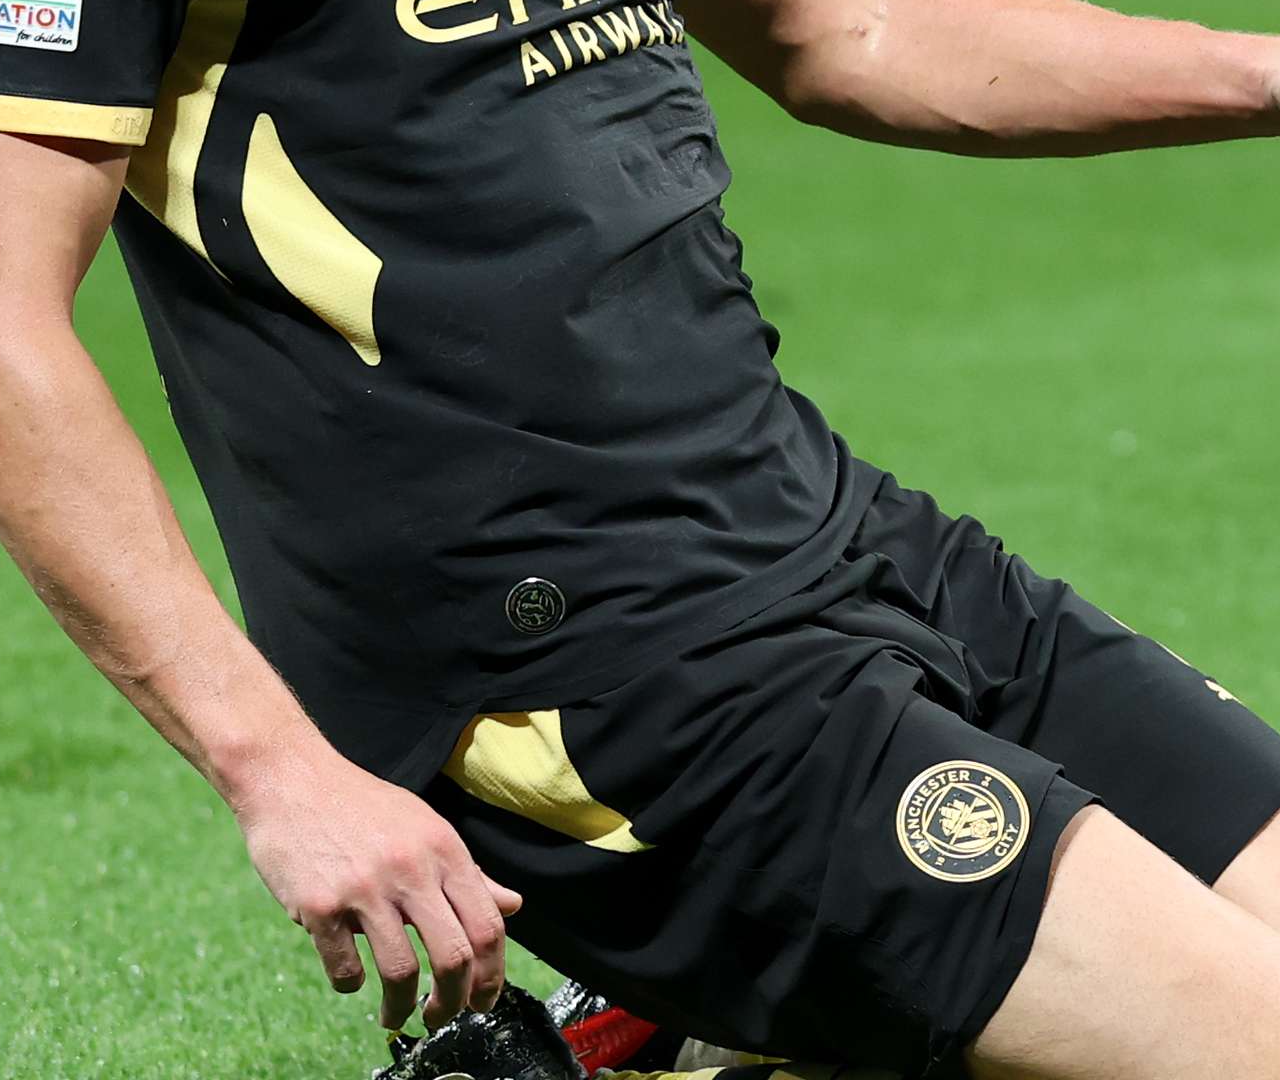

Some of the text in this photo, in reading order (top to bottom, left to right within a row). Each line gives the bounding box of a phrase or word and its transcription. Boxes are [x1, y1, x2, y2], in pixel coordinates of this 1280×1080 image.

[33, 31, 73, 46] children
[907, 770, 1019, 857] MANCHESTER CITY
